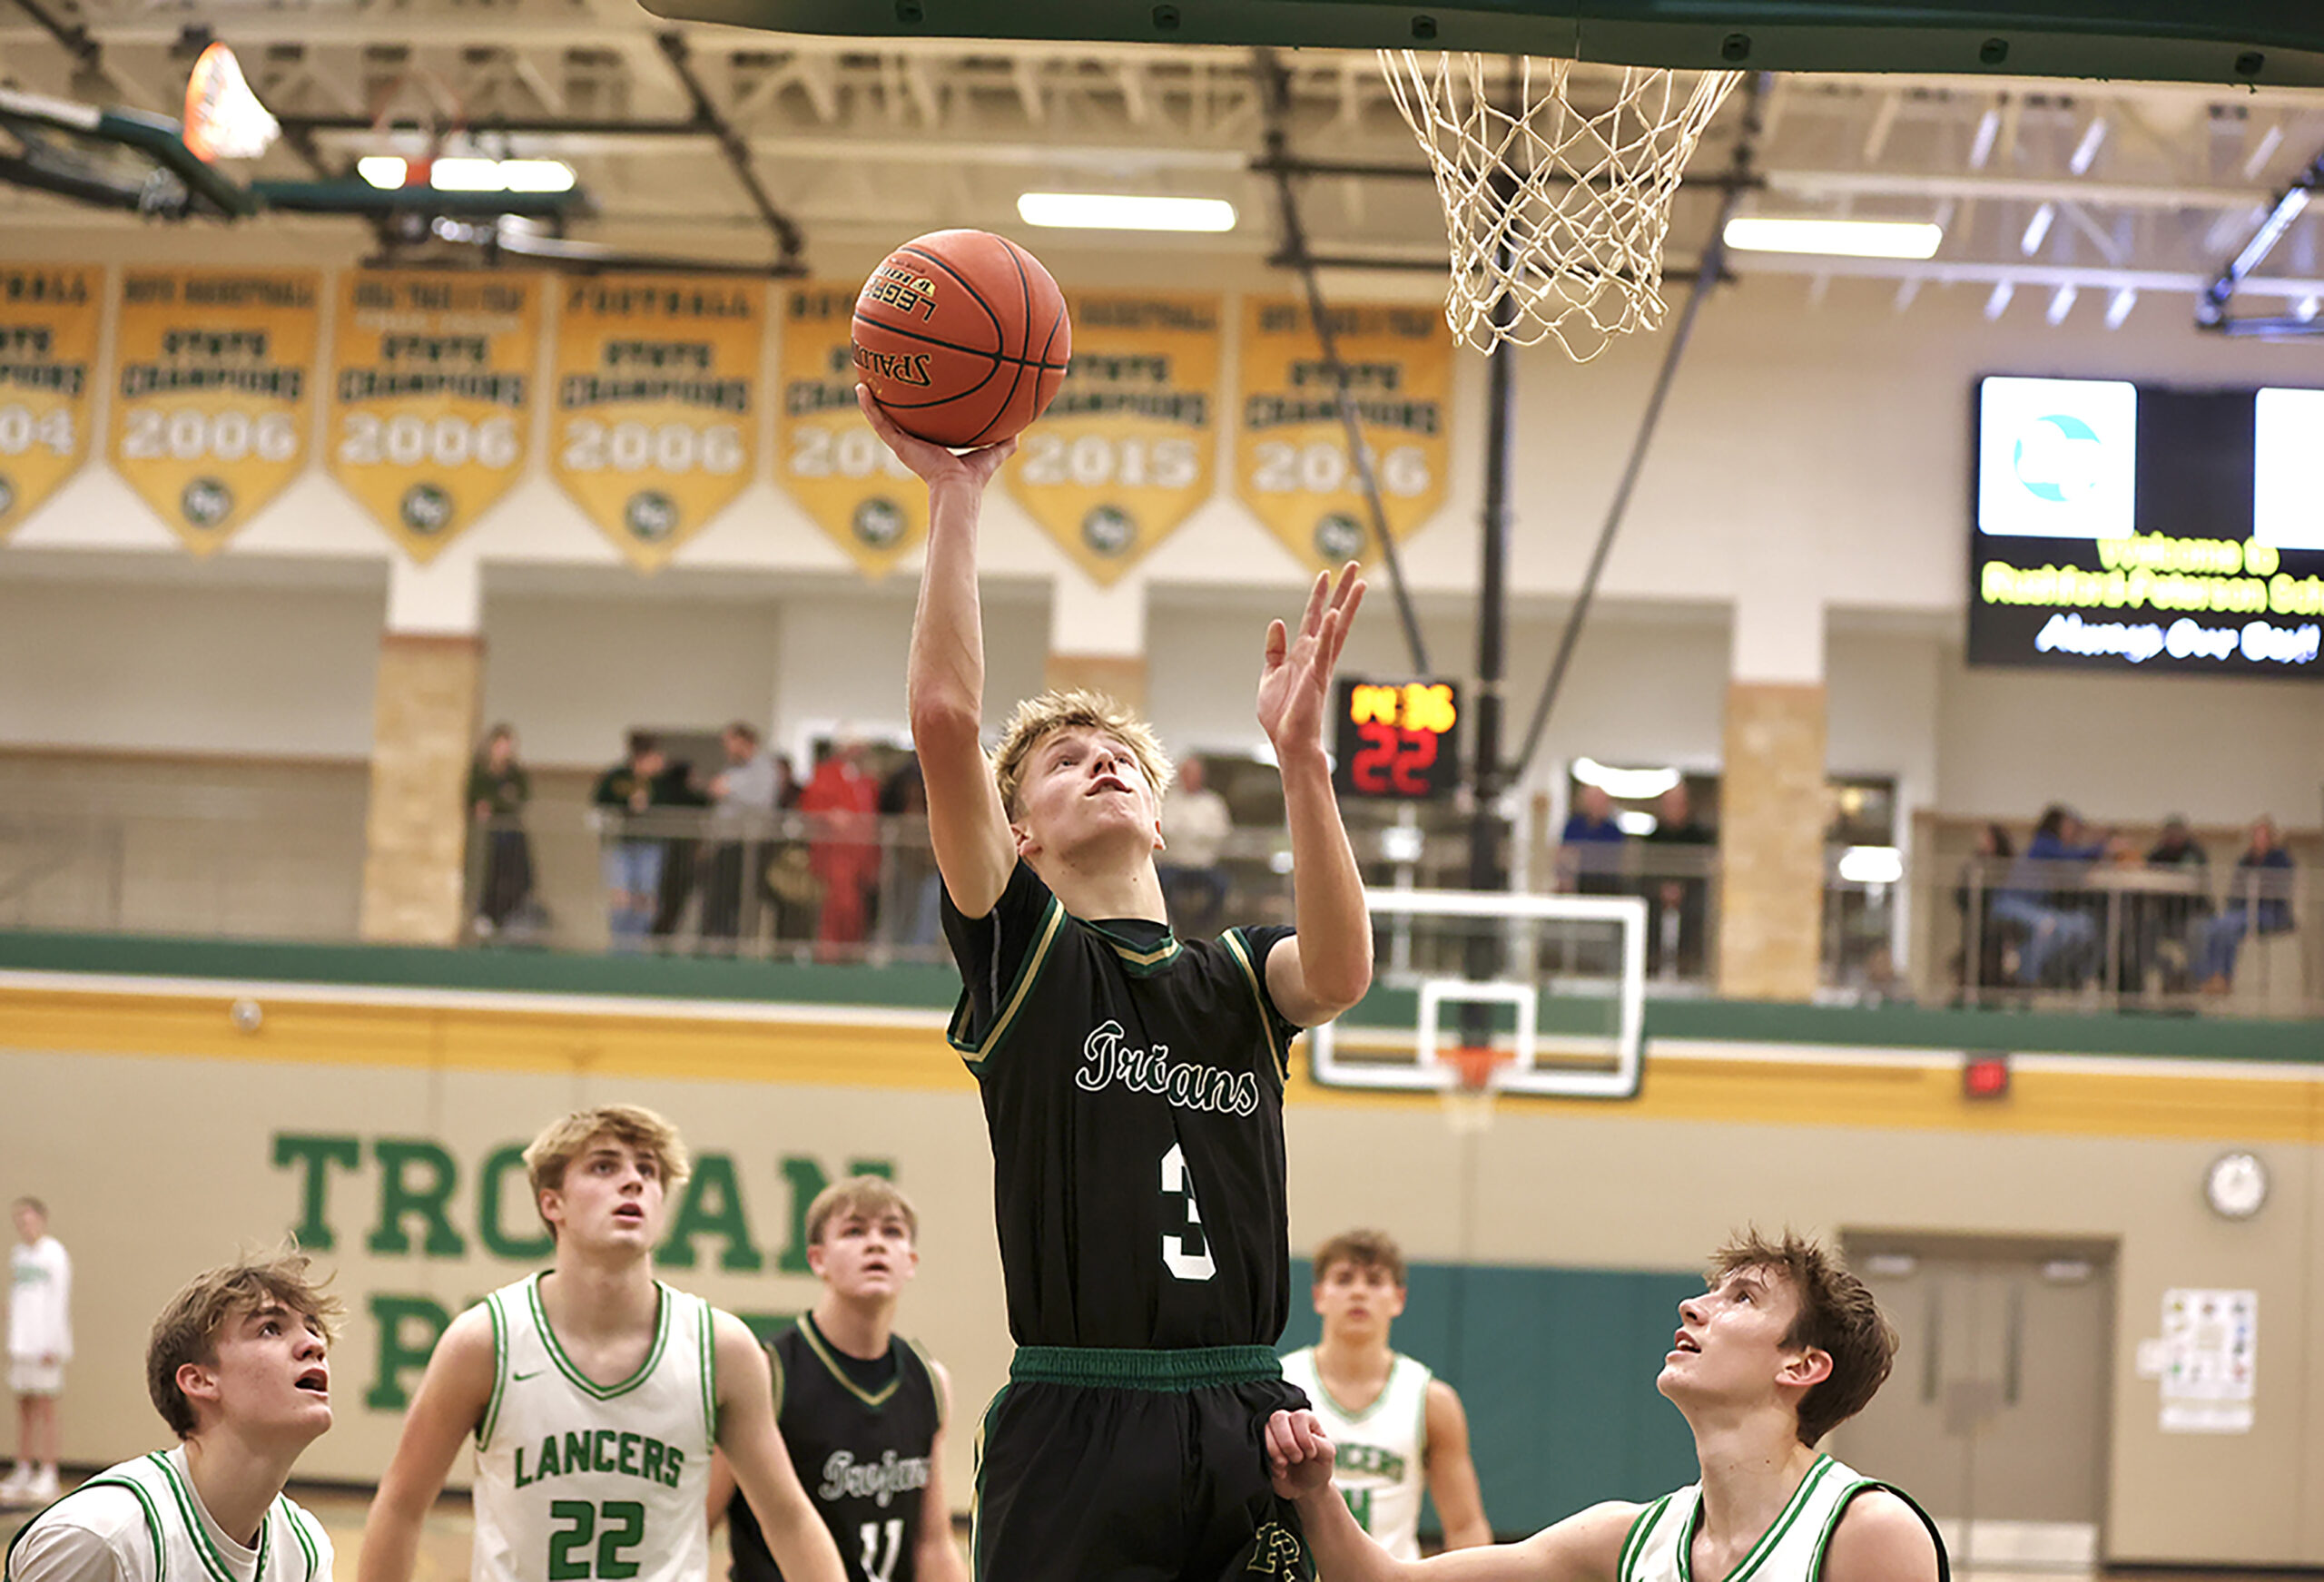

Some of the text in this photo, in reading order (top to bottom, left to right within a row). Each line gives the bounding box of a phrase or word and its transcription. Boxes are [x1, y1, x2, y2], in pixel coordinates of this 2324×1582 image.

[7, 275, 88, 306] BALL
[868, 280, 937, 321] LEGA
[855, 348, 932, 388] SPALD
[0, 405, 74, 456] 04
[123, 408, 298, 461] 2006
[340, 411, 519, 469] 2006
[562, 418, 744, 475] 2006
[274, 1134, 896, 1277] TROAN
[1160, 1142, 1216, 1281] 3
[514, 1430, 684, 1489] LANCERS
[818, 1449, 931, 1508] Trojan
[548, 1498, 645, 1581] 22
